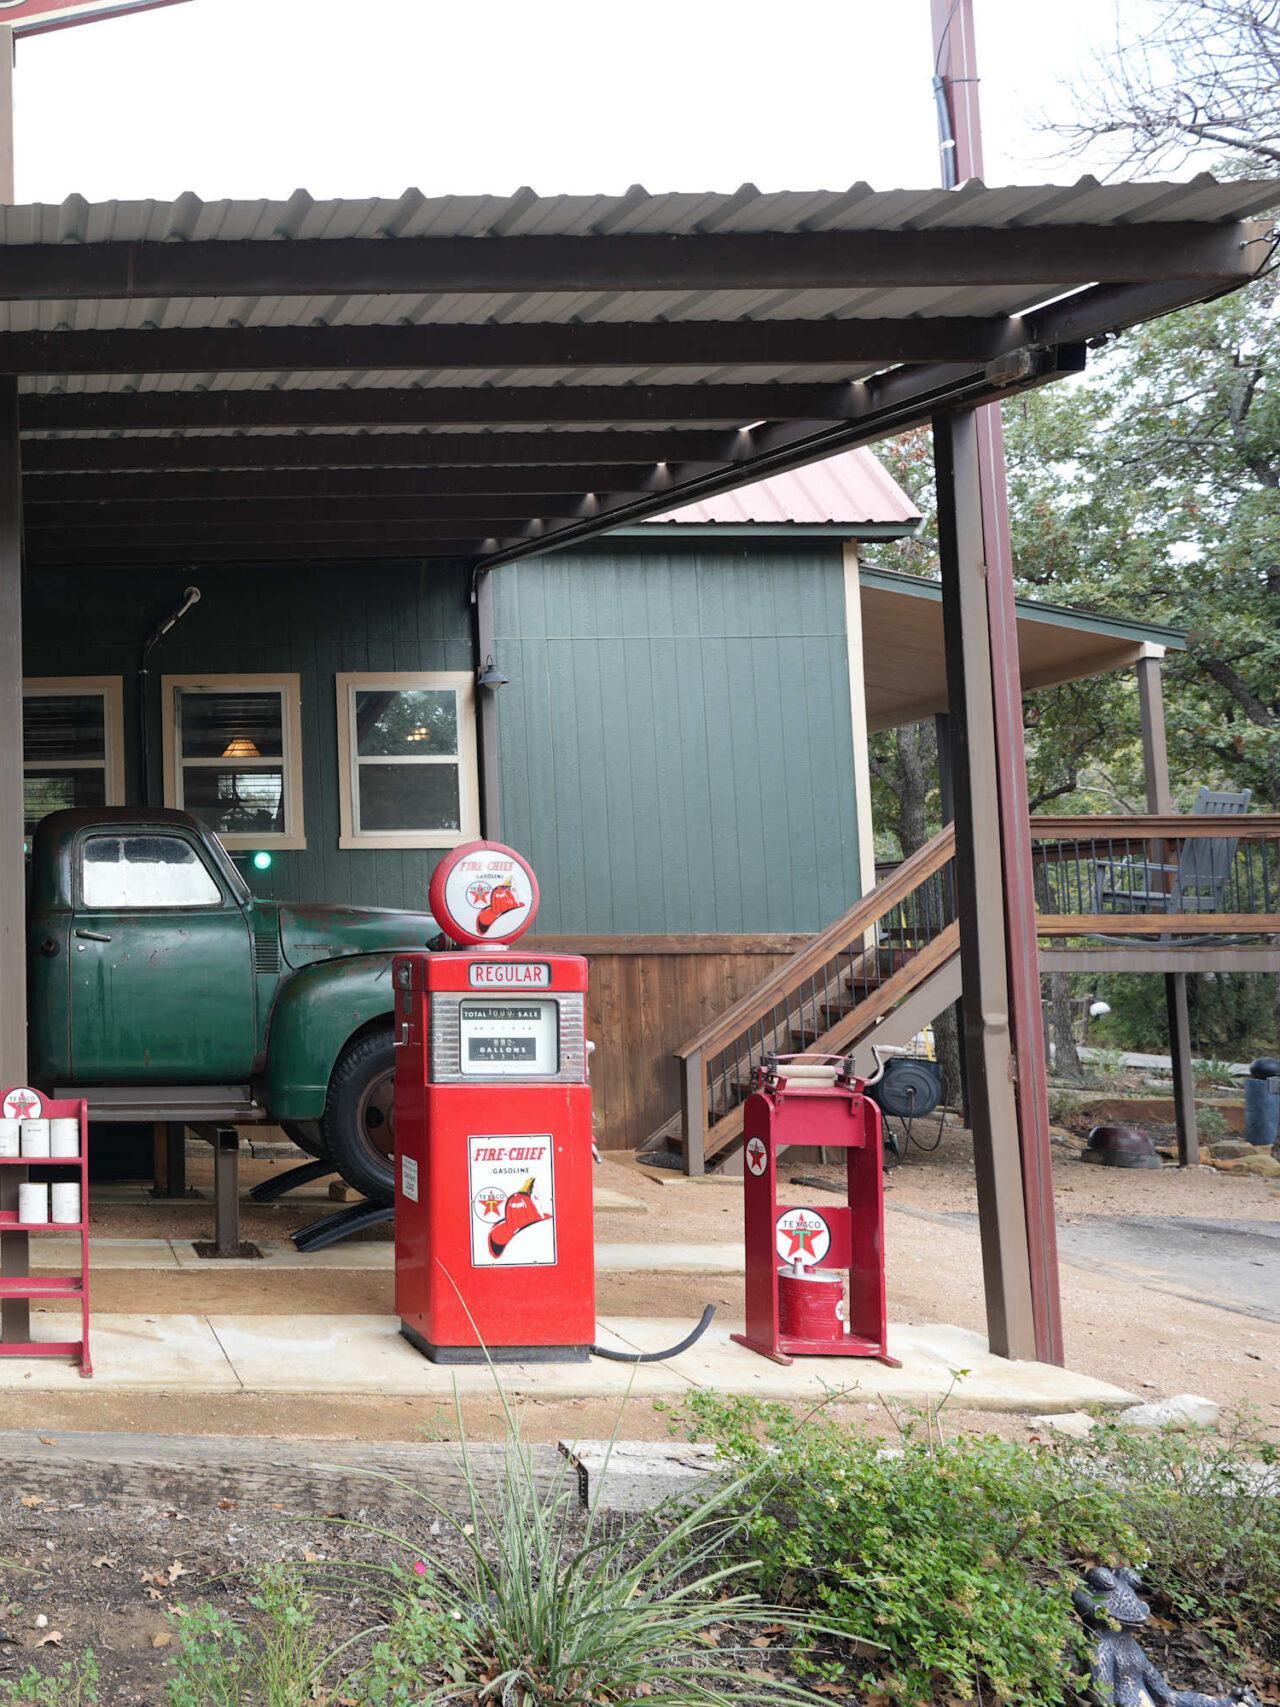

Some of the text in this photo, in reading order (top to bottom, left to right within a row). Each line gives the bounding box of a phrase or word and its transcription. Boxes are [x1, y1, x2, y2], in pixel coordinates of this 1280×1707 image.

[476, 966, 542, 982] REGULAR
[464, 1010, 487, 1018] TOTAL
[517, 1010, 539, 1018] SALE
[479, 1046, 526, 1054] GALLONS
[473, 1147, 546, 1161] FIRE-CHIEF
[492, 1167, 530, 1175] GASOLINE
[783, 1220, 821, 1229] TEXACO
